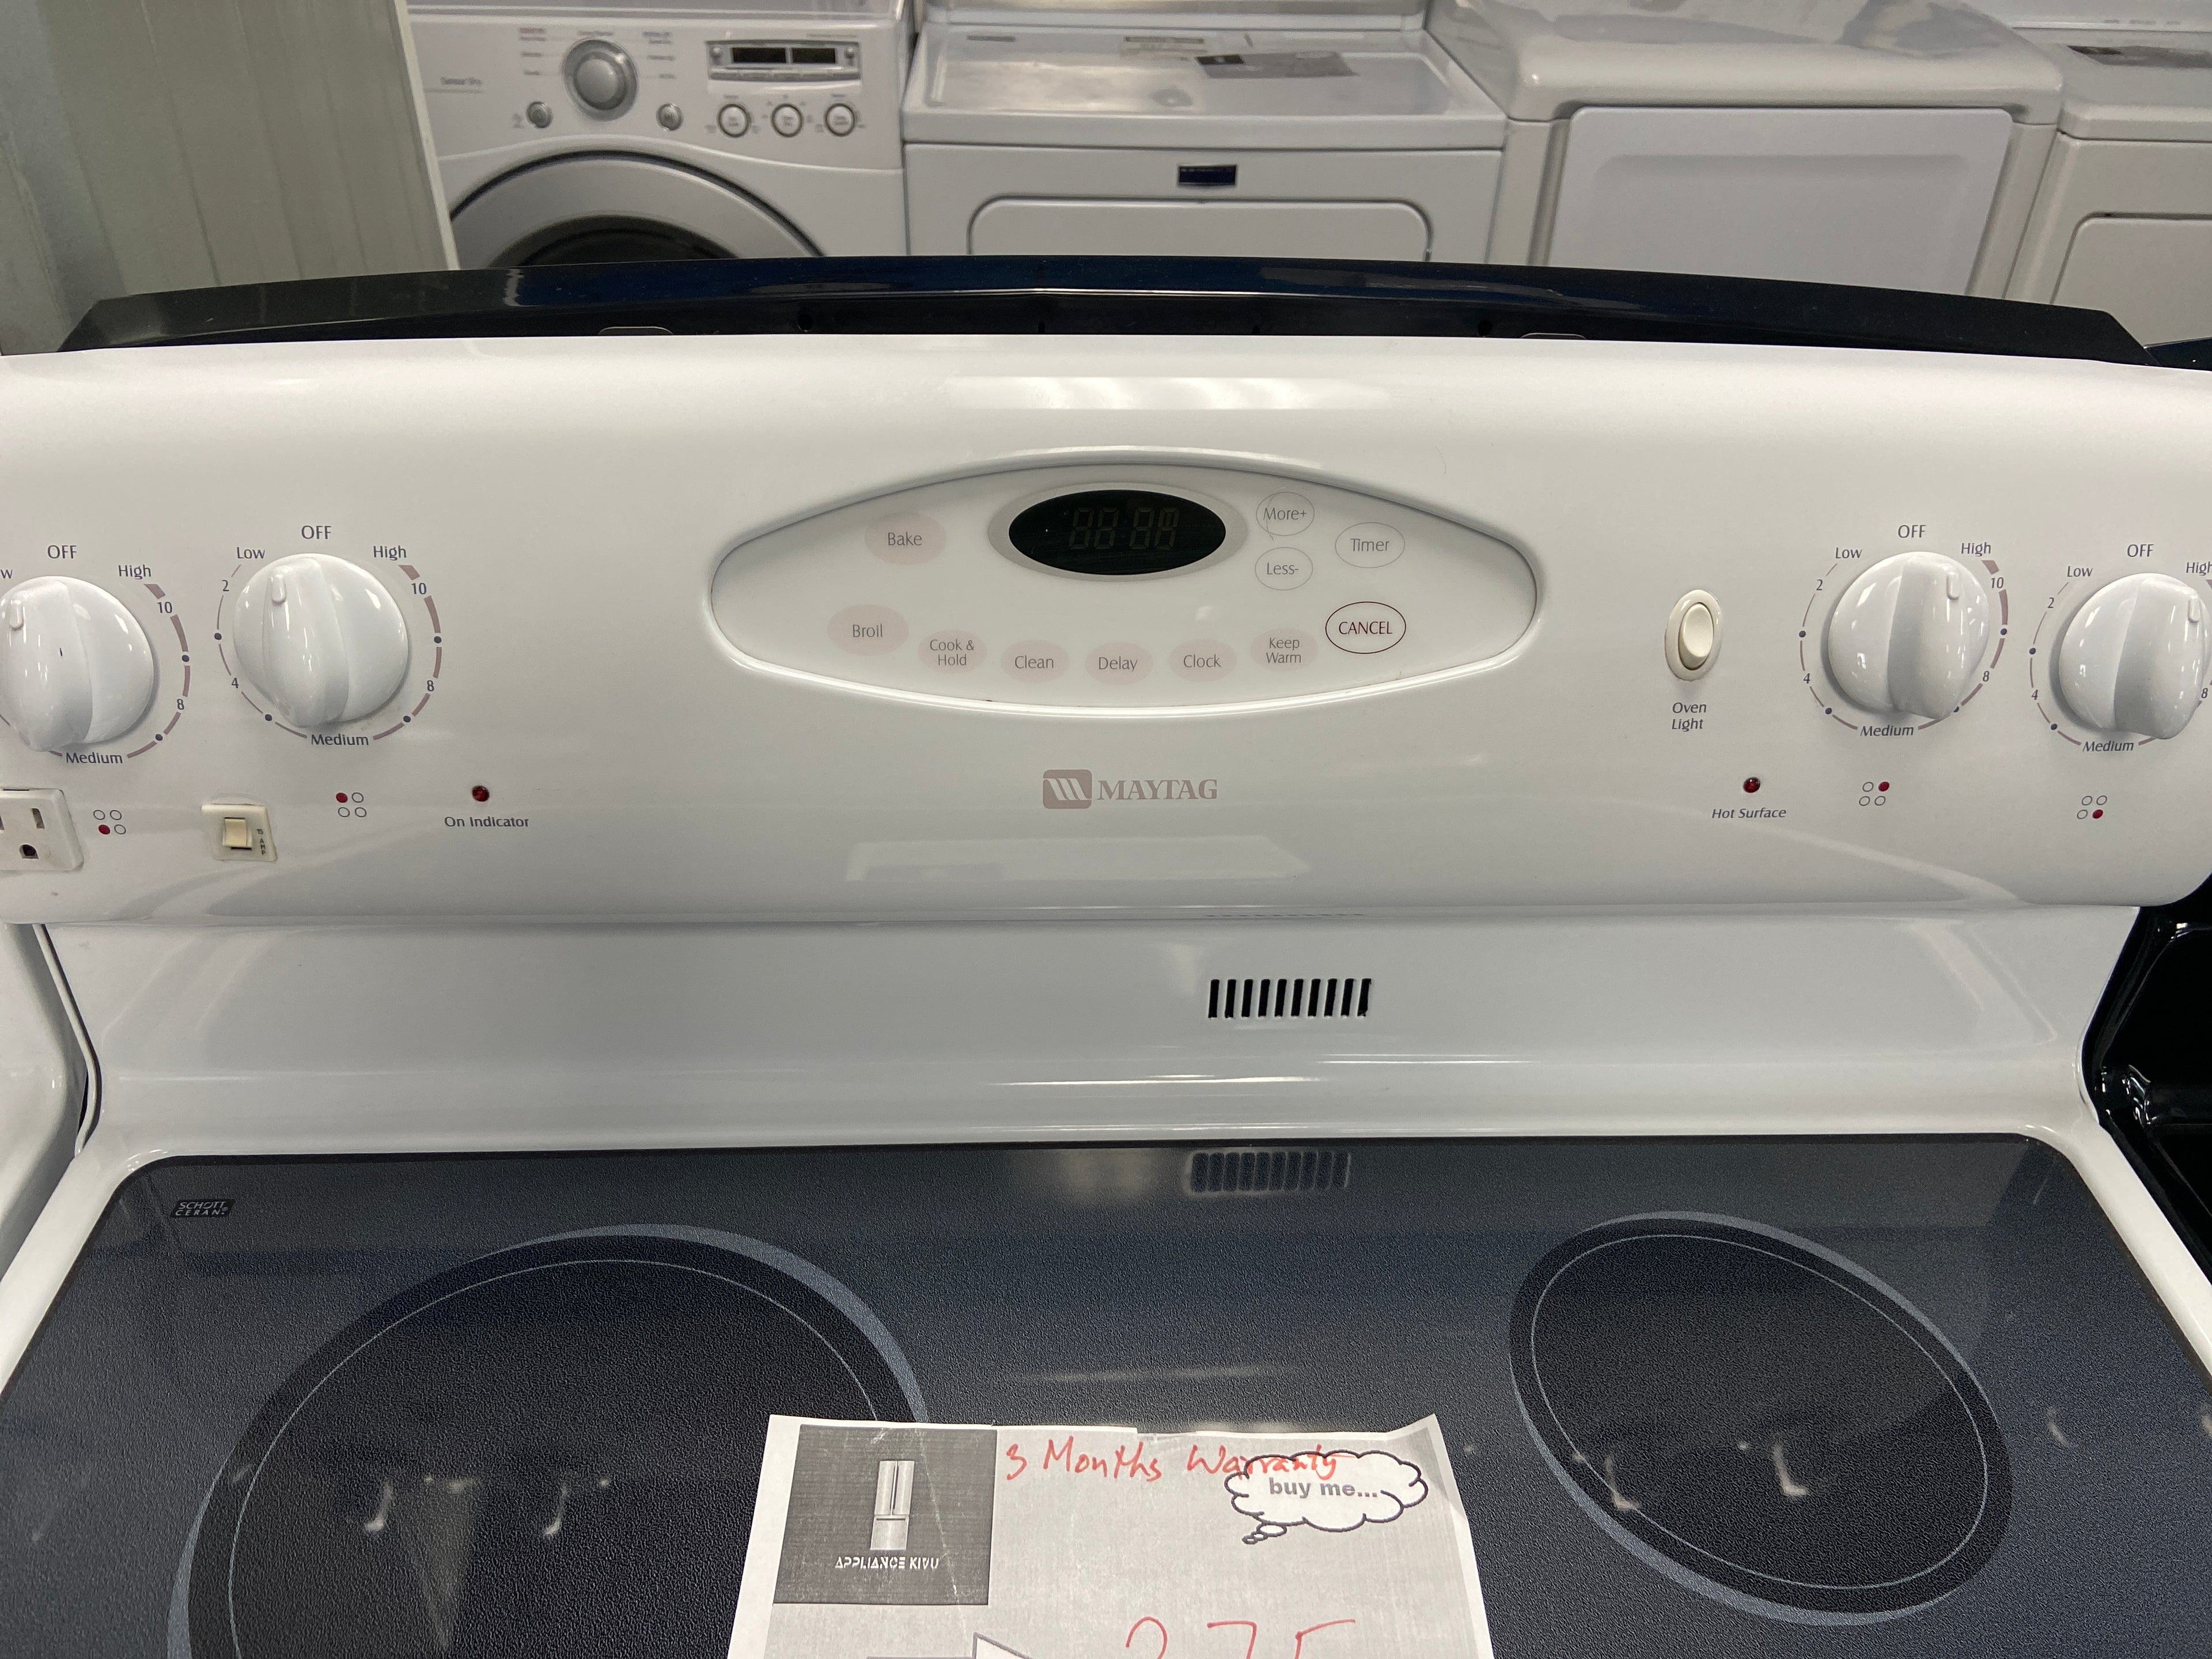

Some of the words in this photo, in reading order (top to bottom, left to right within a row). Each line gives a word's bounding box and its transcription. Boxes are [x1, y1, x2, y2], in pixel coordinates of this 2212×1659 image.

[1263, 507, 1307, 520] More+
[301, 525, 332, 540] OFF
[1897, 524, 1926, 539] OFF
[888, 531, 922, 546] Bake
[1350, 538, 1390, 552] Timer
[47, 545, 77, 559] OFF
[236, 547, 266, 559] Low
[373, 545, 407, 561] High
[1835, 547, 1862, 559] Low
[1961, 541, 1991, 557] High
[2127, 544, 2154, 558] OFF
[118, 564, 151, 580] High
[2067, 566, 2093, 577] Low
[222, 579, 230, 592] 2
[411, 582, 427, 595] 10
[1816, 579, 1823, 591] 2
[1991, 577, 2004, 589] 10
[157, 601, 173, 613] 10
[2047, 597, 2055, 609] 2
[852, 623, 883, 638] Broil
[1338, 621, 1393, 635] CANCEL
[930, 638, 963, 651] Cook
[966, 639, 975, 651] &
[1269, 637, 1300, 651] Keep
[938, 653, 967, 666] Hold
[1014, 654, 1054, 669] Clean
[1099, 656, 1138, 672] Delay
[1183, 654, 1222, 668] Clock
[1266, 652, 1301, 664] Warm
[231, 677, 239, 689] 4
[1803, 673, 1810, 684] 4
[1982, 671, 1990, 682] 8
[426, 680, 435, 692] 8
[2031, 689, 2039, 700] 4
[2200, 687, 2209, 699] 8
[176, 698, 185, 710] 8
[1672, 702, 1707, 714] Oven
[1672, 717, 1704, 732] Light
[1860, 724, 1914, 737] Medium
[311, 733, 369, 745] Medium
[2082, 740, 2134, 752] Medium
[66, 751, 123, 764] Medium
[1096, 779, 1217, 801] MAYTAG
[1711, 809, 1735, 819] Hot
[1738, 807, 1787, 819] Surface
[444, 816, 465, 827] On
[469, 816, 529, 827] Indicator
[177, 1200, 228, 1210] SCHOTT
[1005, 1442, 1028, 1481] 3
[1042, 1435, 1163, 1483] Months
[1185, 1442, 1357, 1481] Warranty
[1268, 1477, 1311, 1498] buy
[834, 1556, 907, 1570] APPLIANCE
[908, 1556, 940, 1571] KIVU
